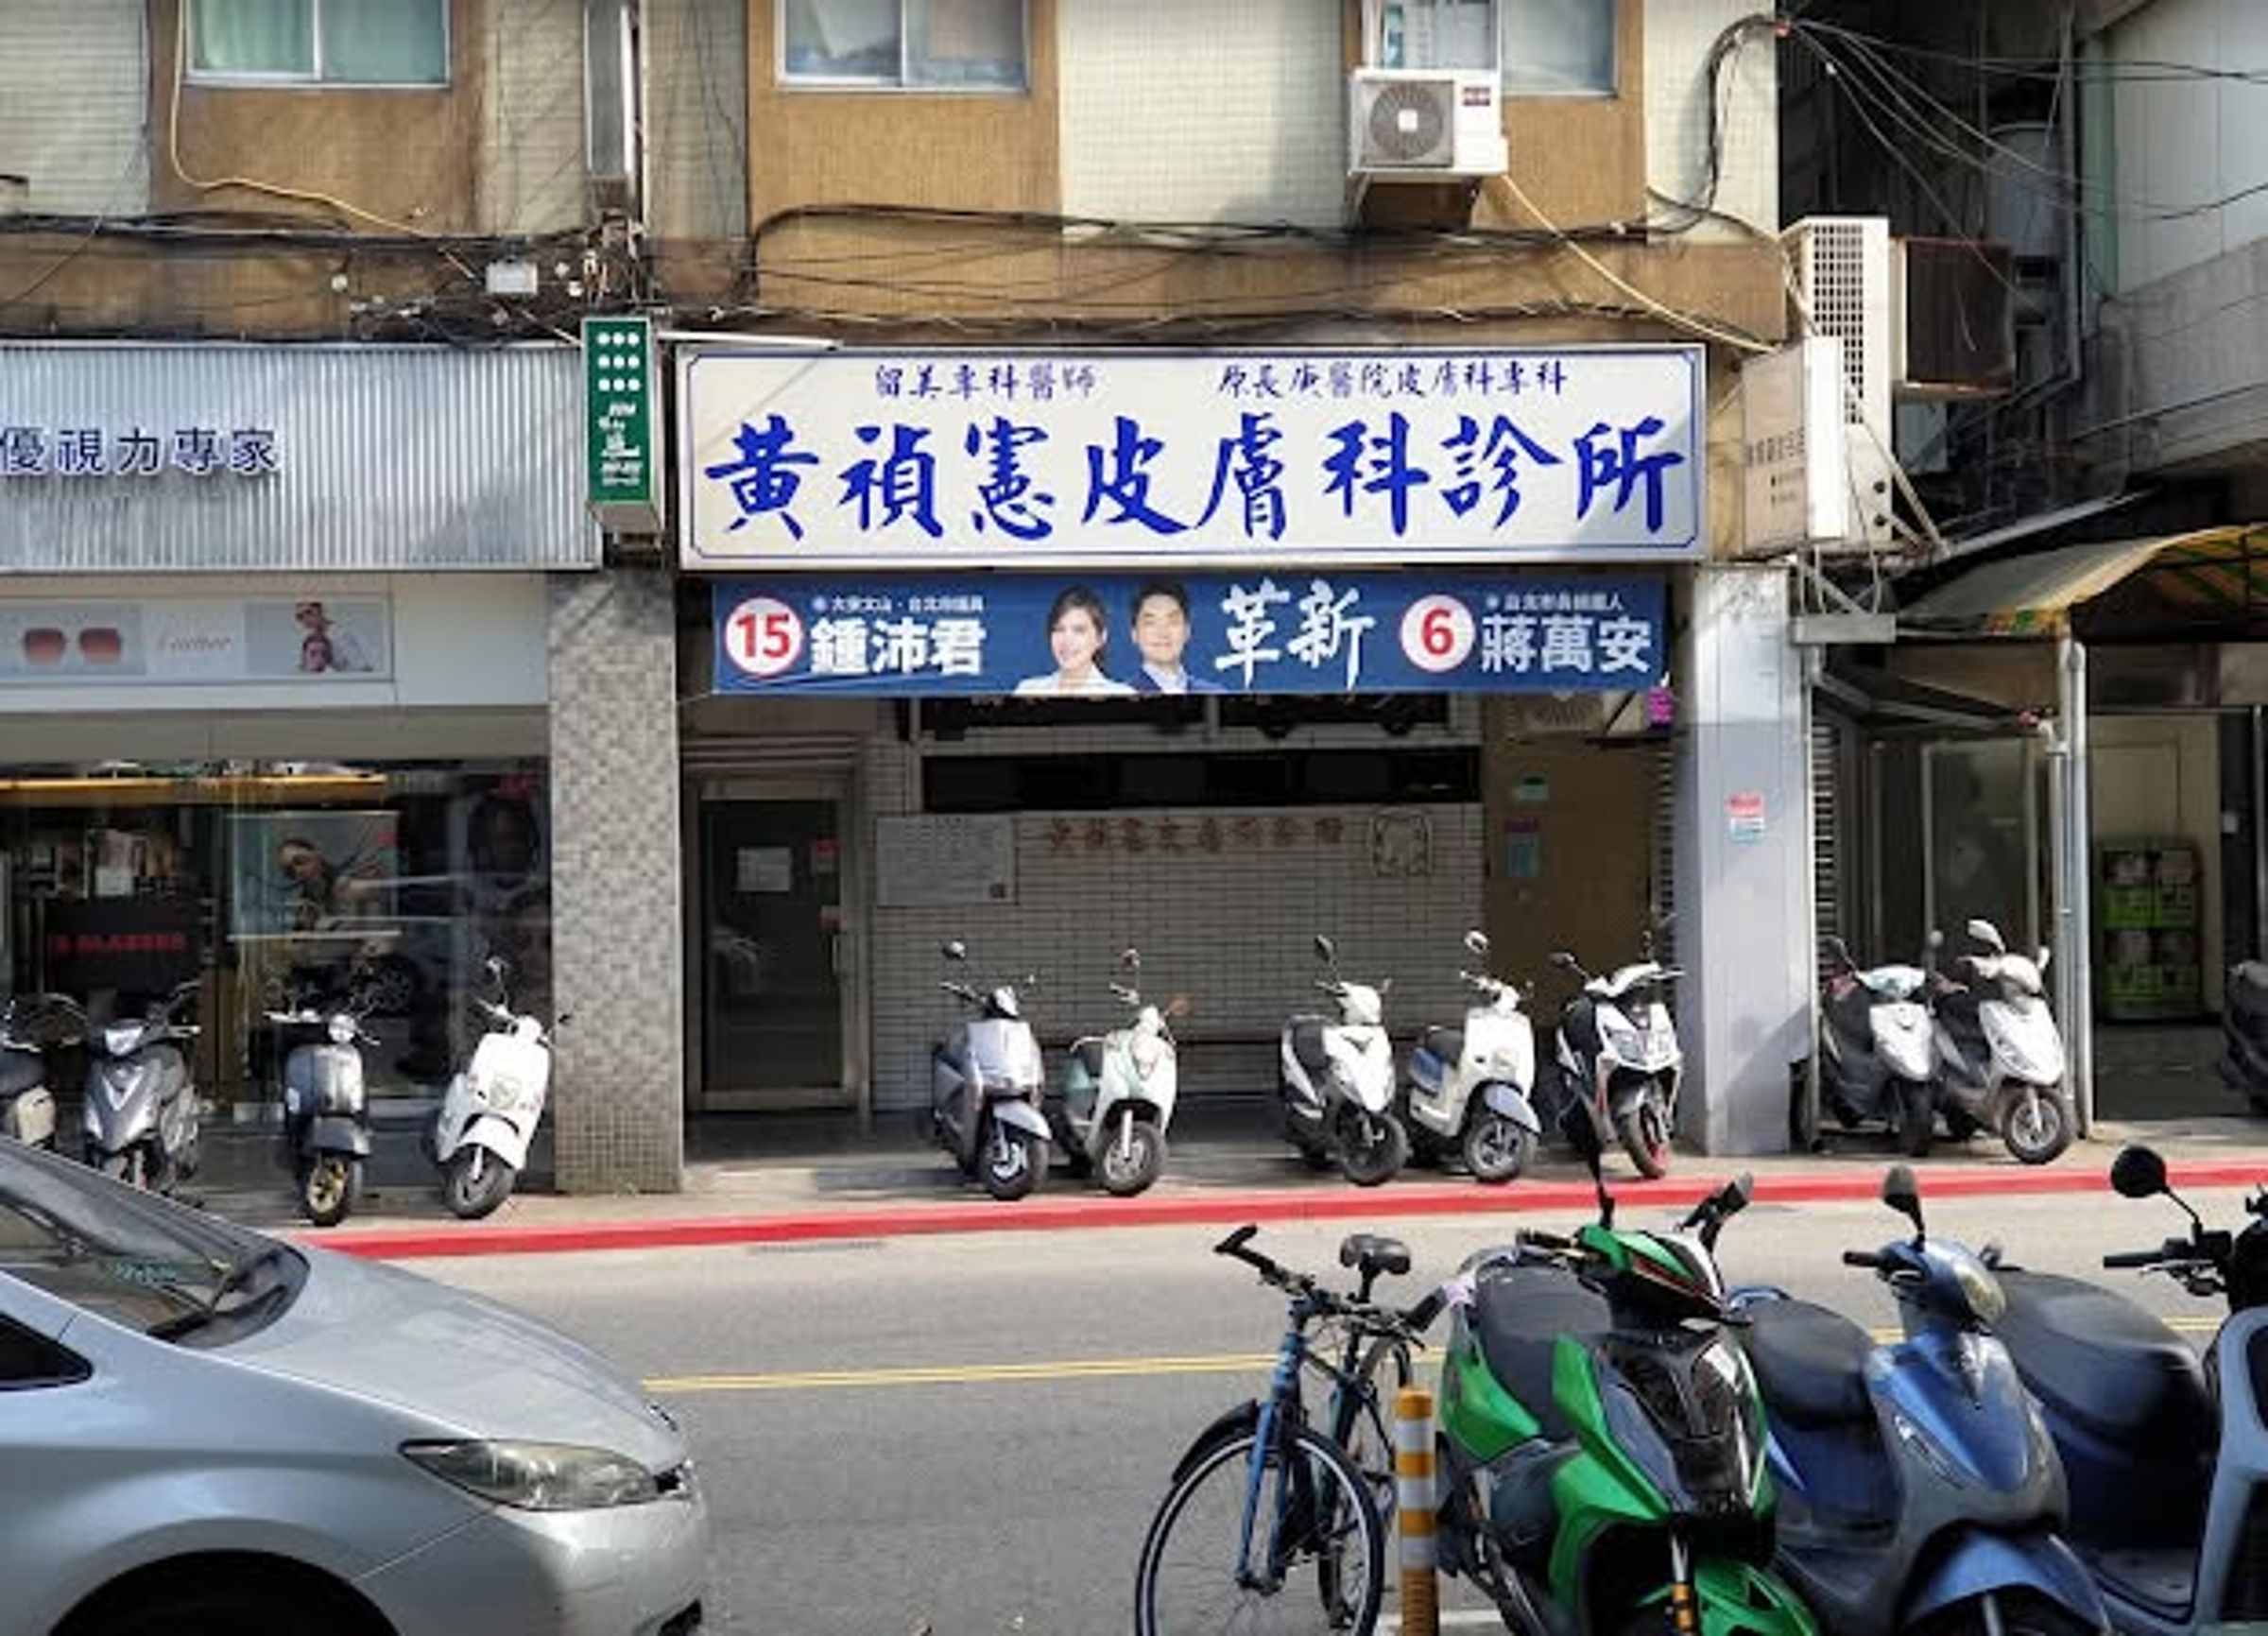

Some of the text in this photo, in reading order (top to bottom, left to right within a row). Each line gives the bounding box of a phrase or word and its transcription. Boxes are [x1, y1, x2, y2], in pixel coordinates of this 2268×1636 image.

[875, 363, 1096, 399] 留美專科醫師
[1218, 360, 1568, 398] 原長庚醫院皮膚科專科
[0, 426, 276, 473] 優視力專家
[705, 413, 1685, 542] 黃禎憲皮膚科診所
[737, 614, 790, 658] 15
[1214, 577, 1375, 692] 革新
[1421, 610, 1454, 655] 6
[1482, 614, 1652, 673] 蔣萬安
